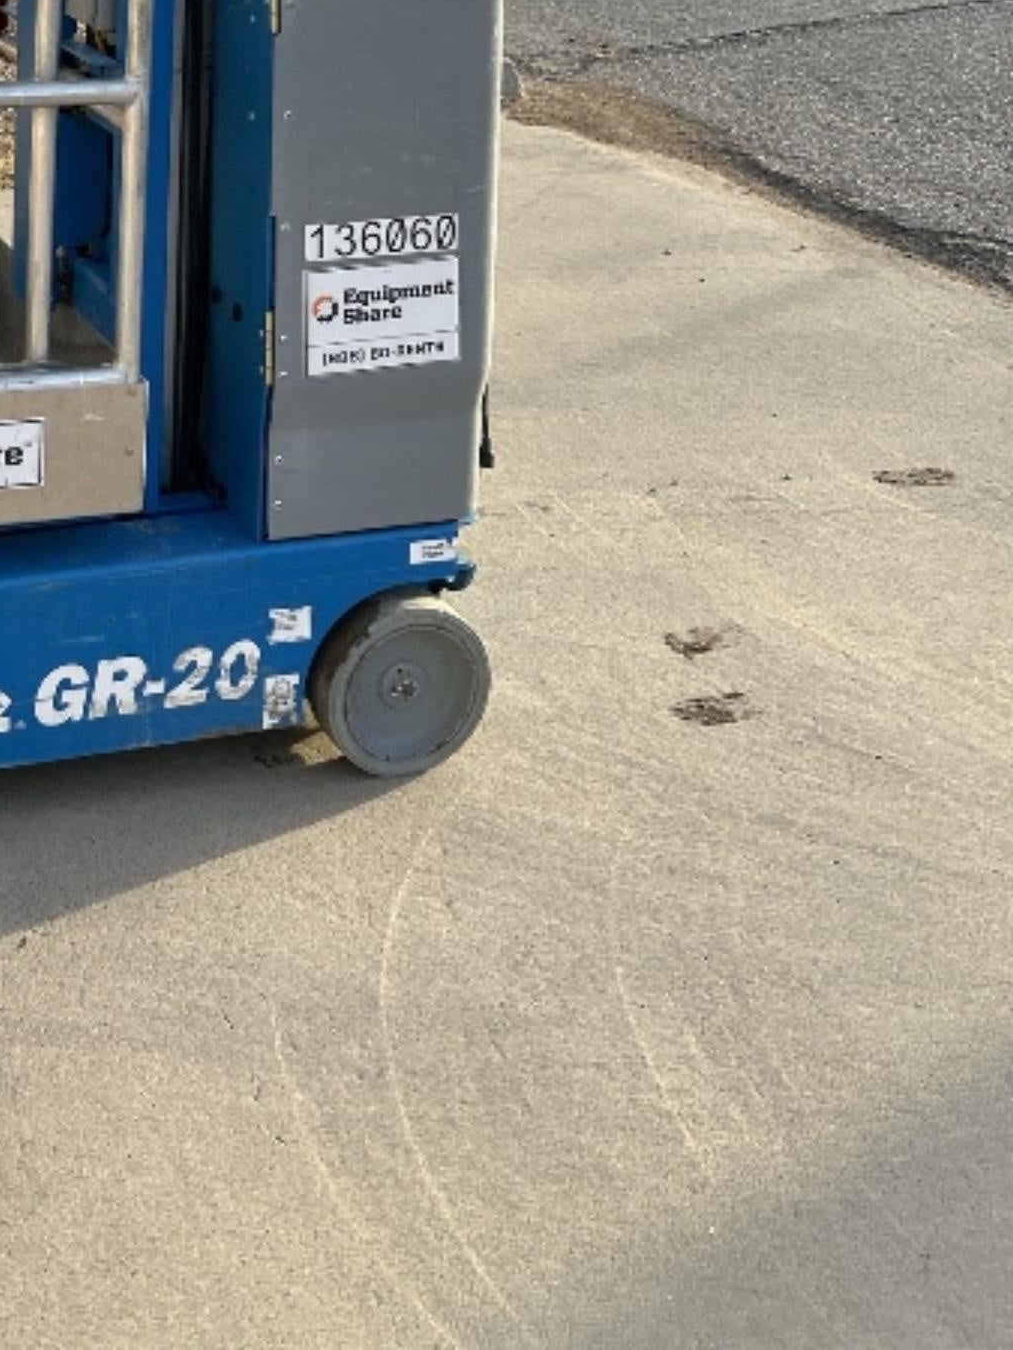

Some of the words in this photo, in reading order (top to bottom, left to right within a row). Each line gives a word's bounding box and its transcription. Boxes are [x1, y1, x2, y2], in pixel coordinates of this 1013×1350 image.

[310, 215, 456, 259] 136060
[343, 278, 455, 305] Equipment
[343, 305, 403, 324] Share
[33, 639, 262, 727] GR-20
